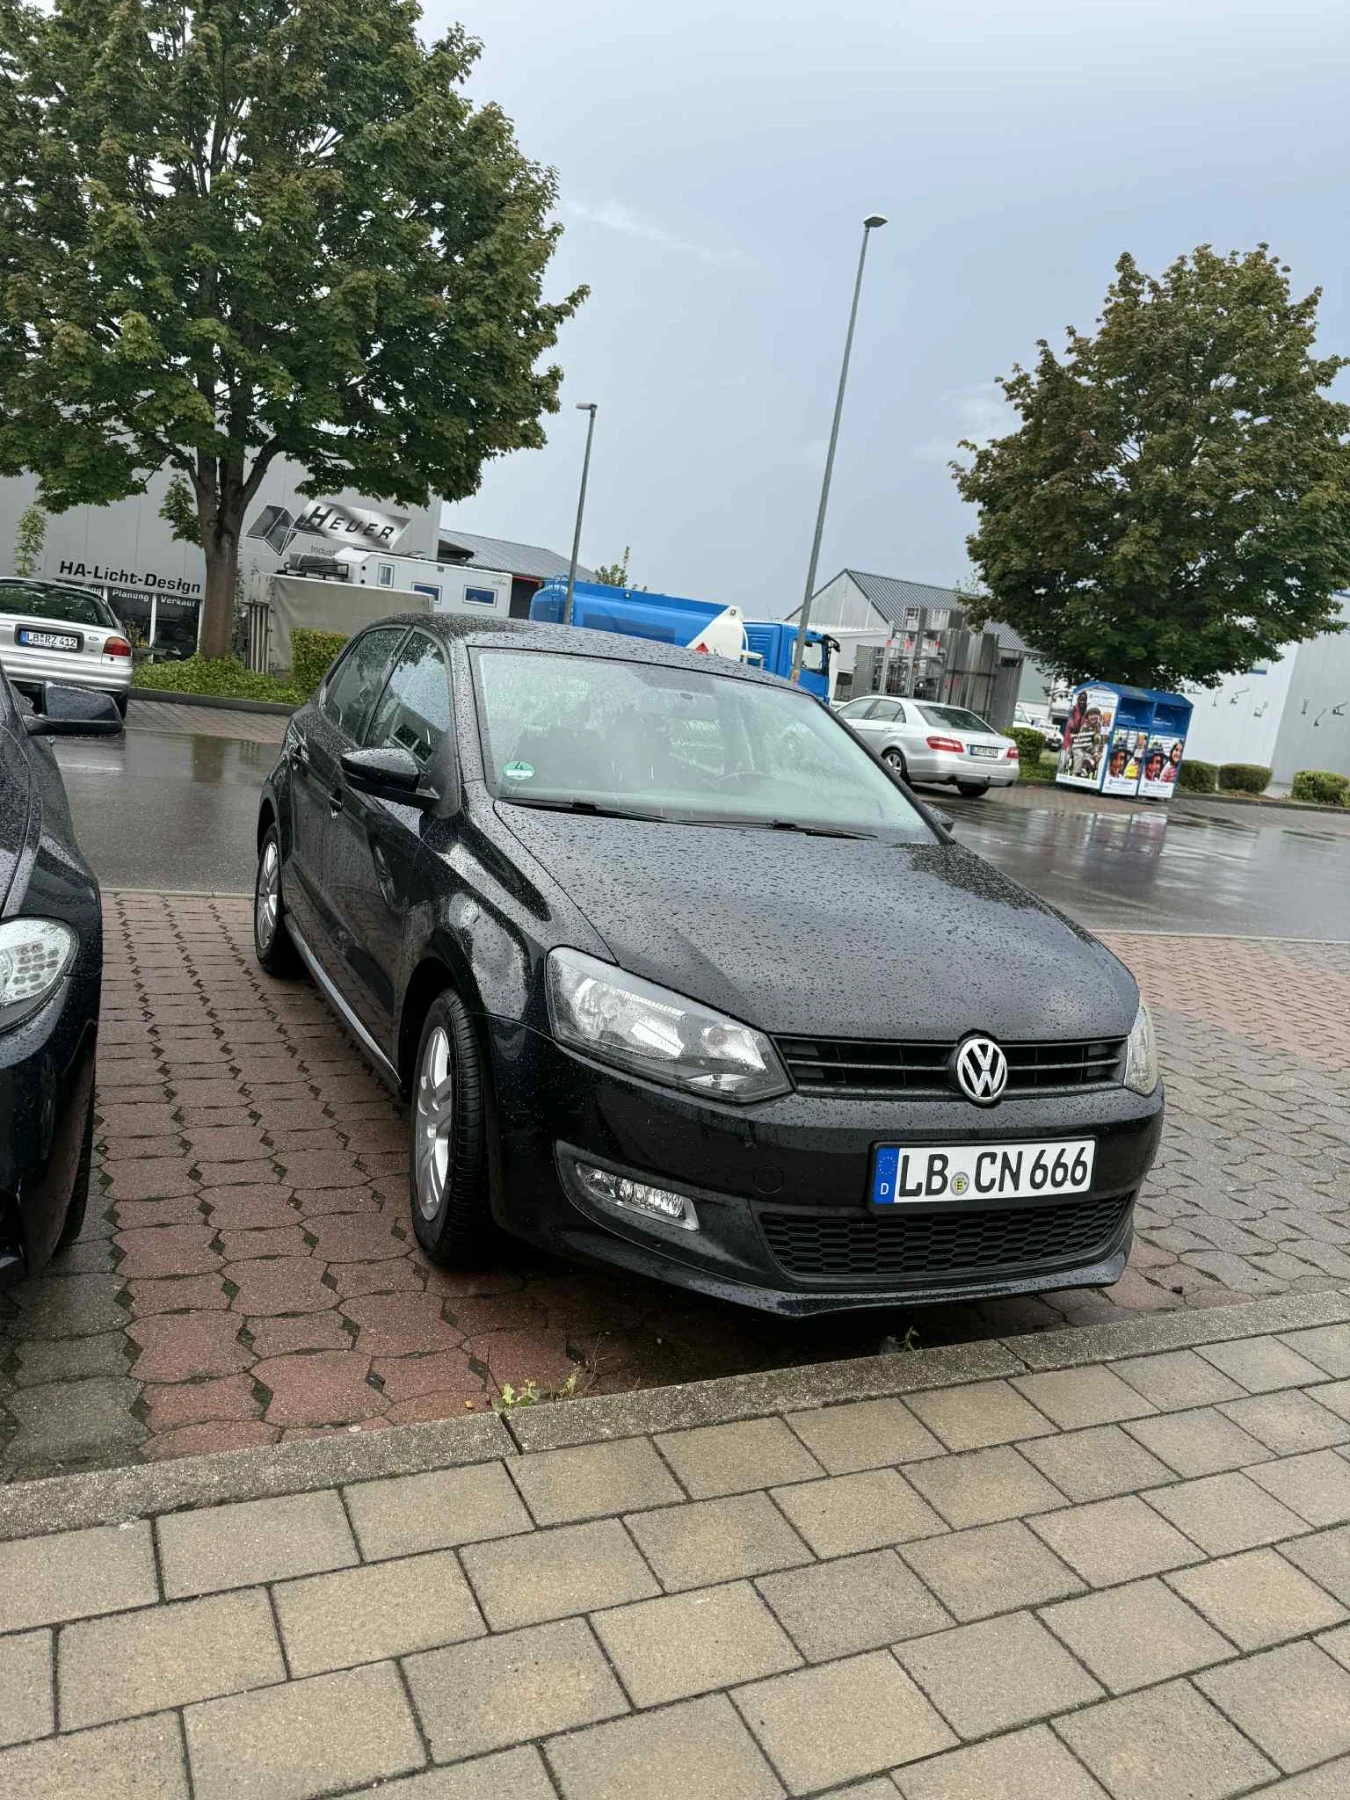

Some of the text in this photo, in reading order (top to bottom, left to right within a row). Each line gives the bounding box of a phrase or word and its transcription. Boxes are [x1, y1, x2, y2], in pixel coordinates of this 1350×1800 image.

[305, 505, 395, 539] HEUER
[59, 560, 201, 595] HA-Licht-Design
[111, 588, 150, 602] Planung
[160, 595, 196, 608] Verkauf
[880, 1147, 1088, 1197] D LB CN 666
